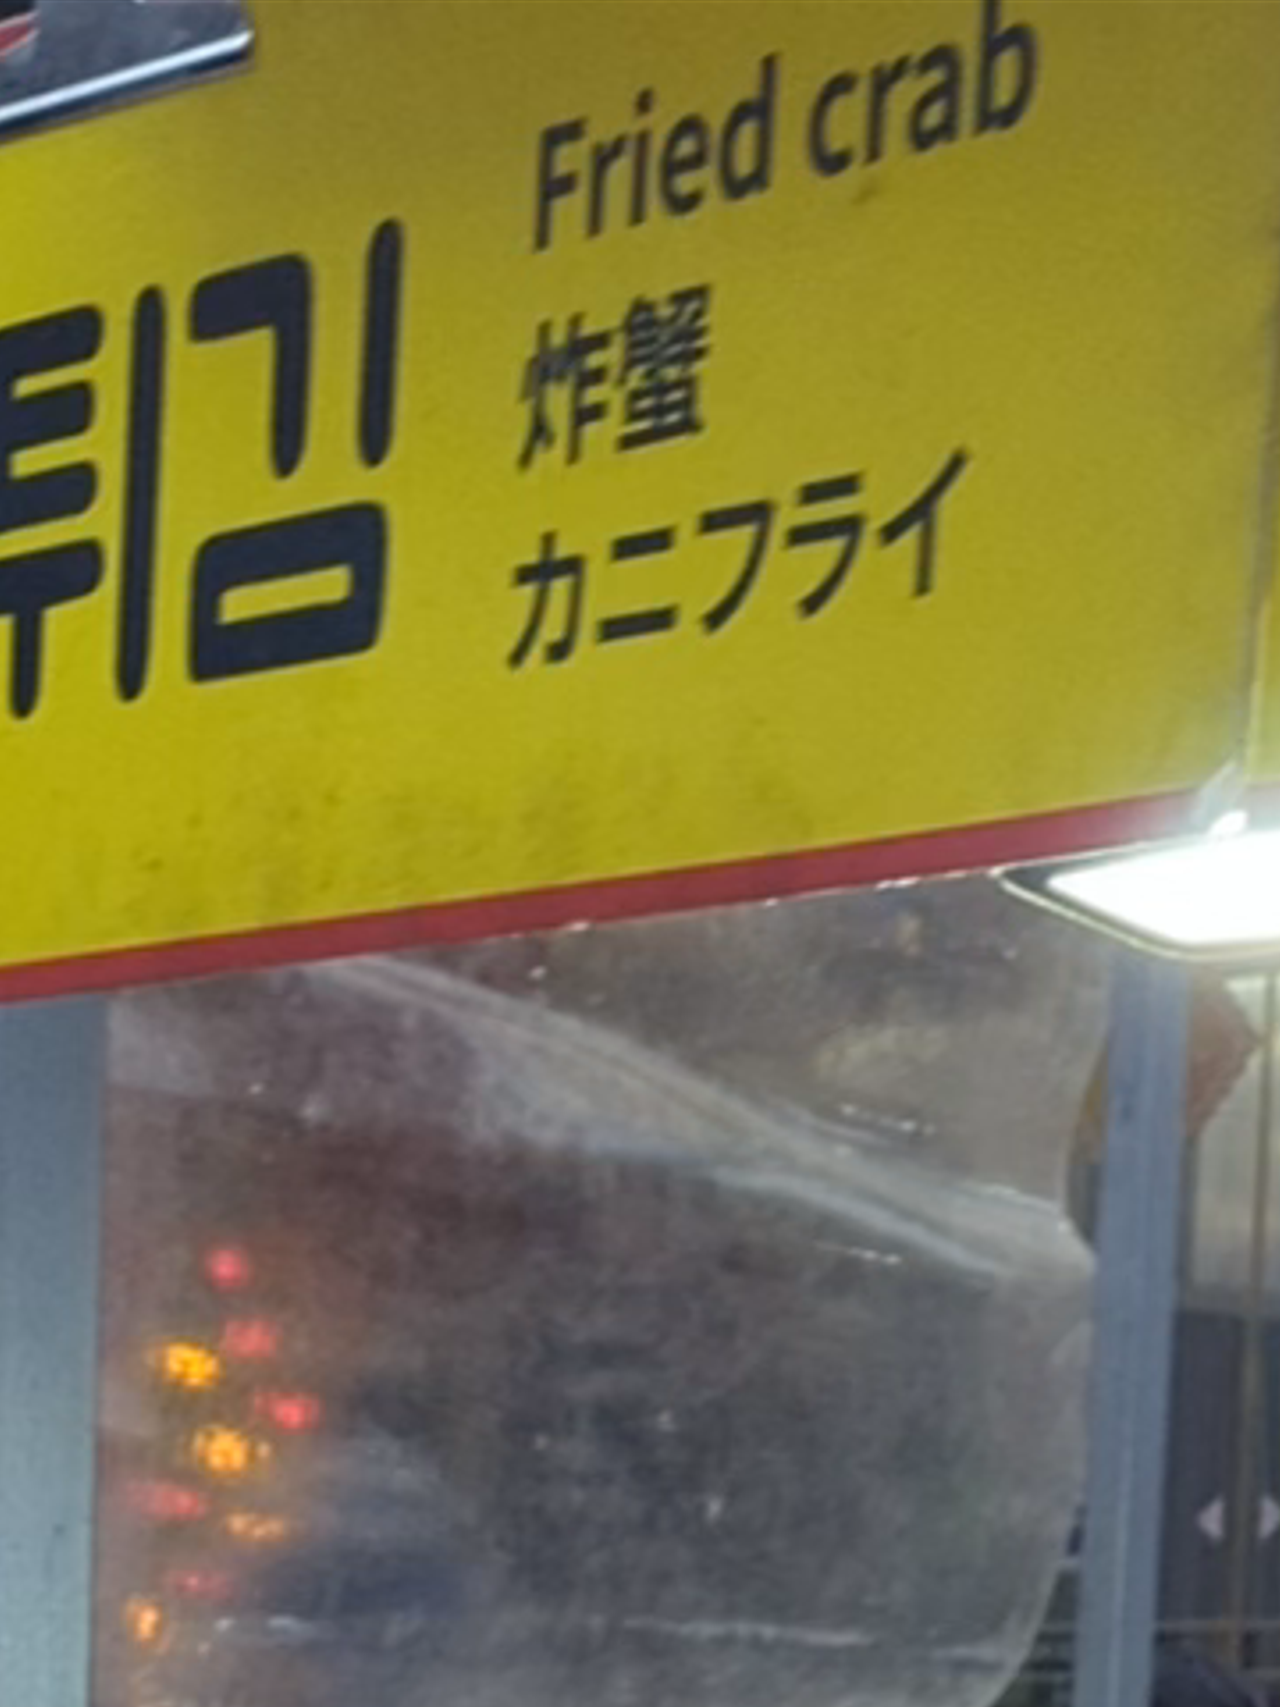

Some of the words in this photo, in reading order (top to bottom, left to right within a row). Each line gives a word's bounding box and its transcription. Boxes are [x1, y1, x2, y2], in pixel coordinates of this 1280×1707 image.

[533, 52, 778, 252] Fried
[807, 0, 1038, 178] crab
[517, 282, 713, 474] 炸蟹
[506, 446, 973, 670] カニフライ
